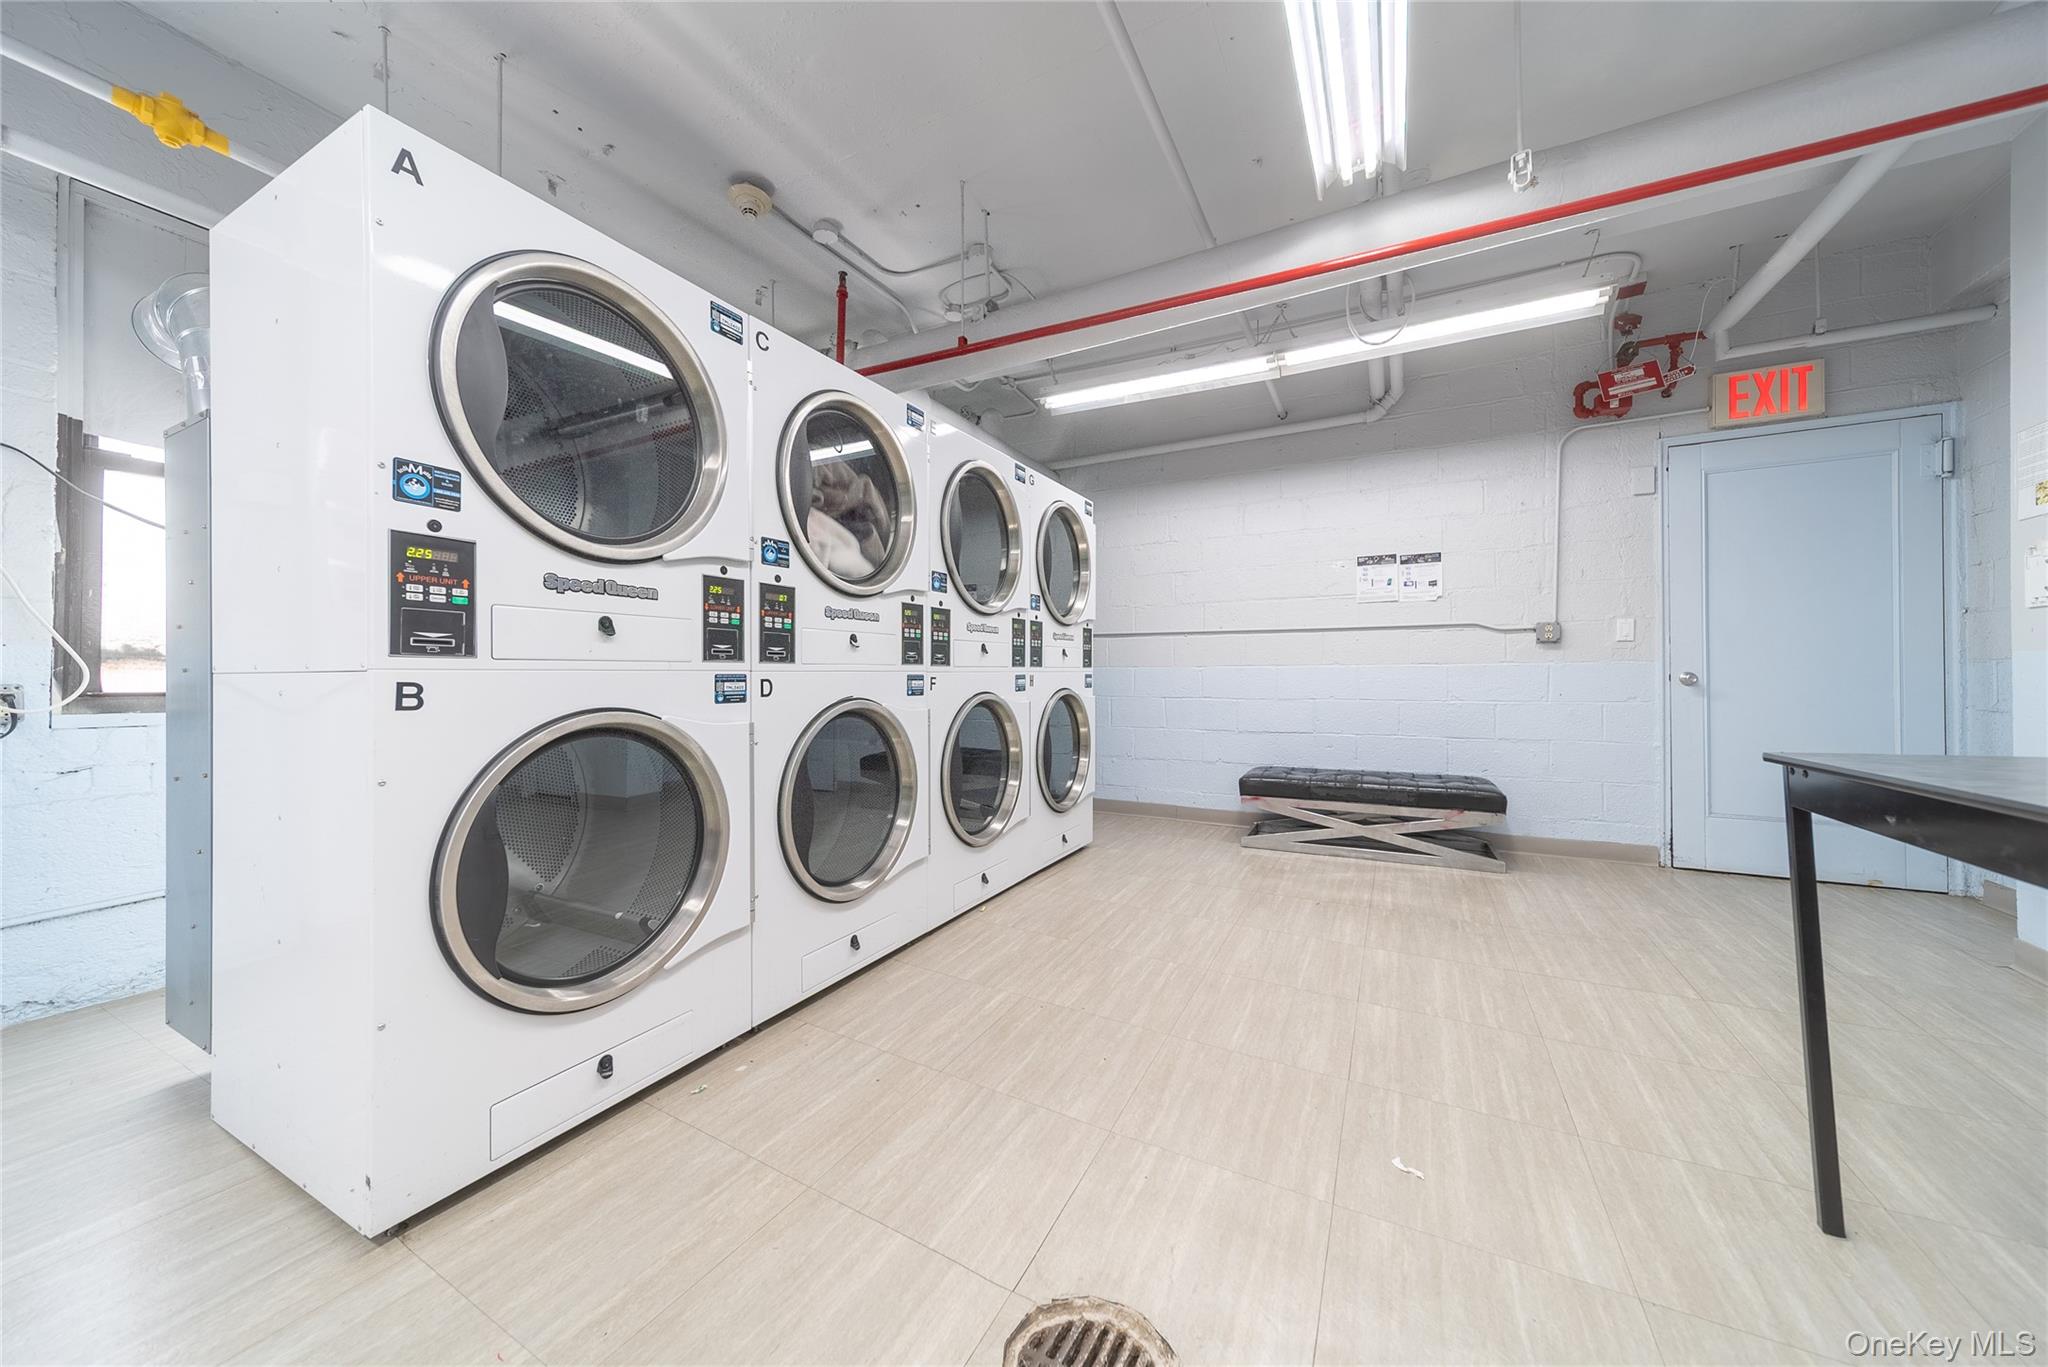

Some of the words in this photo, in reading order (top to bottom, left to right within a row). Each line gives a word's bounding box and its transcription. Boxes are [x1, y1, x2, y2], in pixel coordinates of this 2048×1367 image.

[391, 147, 424, 187] A
[755, 331, 770, 352] C
[1728, 364, 1814, 419] EXIT
[1028, 474, 1036, 486] G
[408, 574, 438, 584] UPPER
[439, 577, 458, 586] UNIT
[543, 572, 605, 594] Speed
[605, 580, 659, 601] Queen
[825, 605, 853, 621] Speed
[853, 608, 880, 623] Queen
[760, 678, 773, 698] D
[930, 677, 937, 691] F
[395, 682, 424, 711] B
